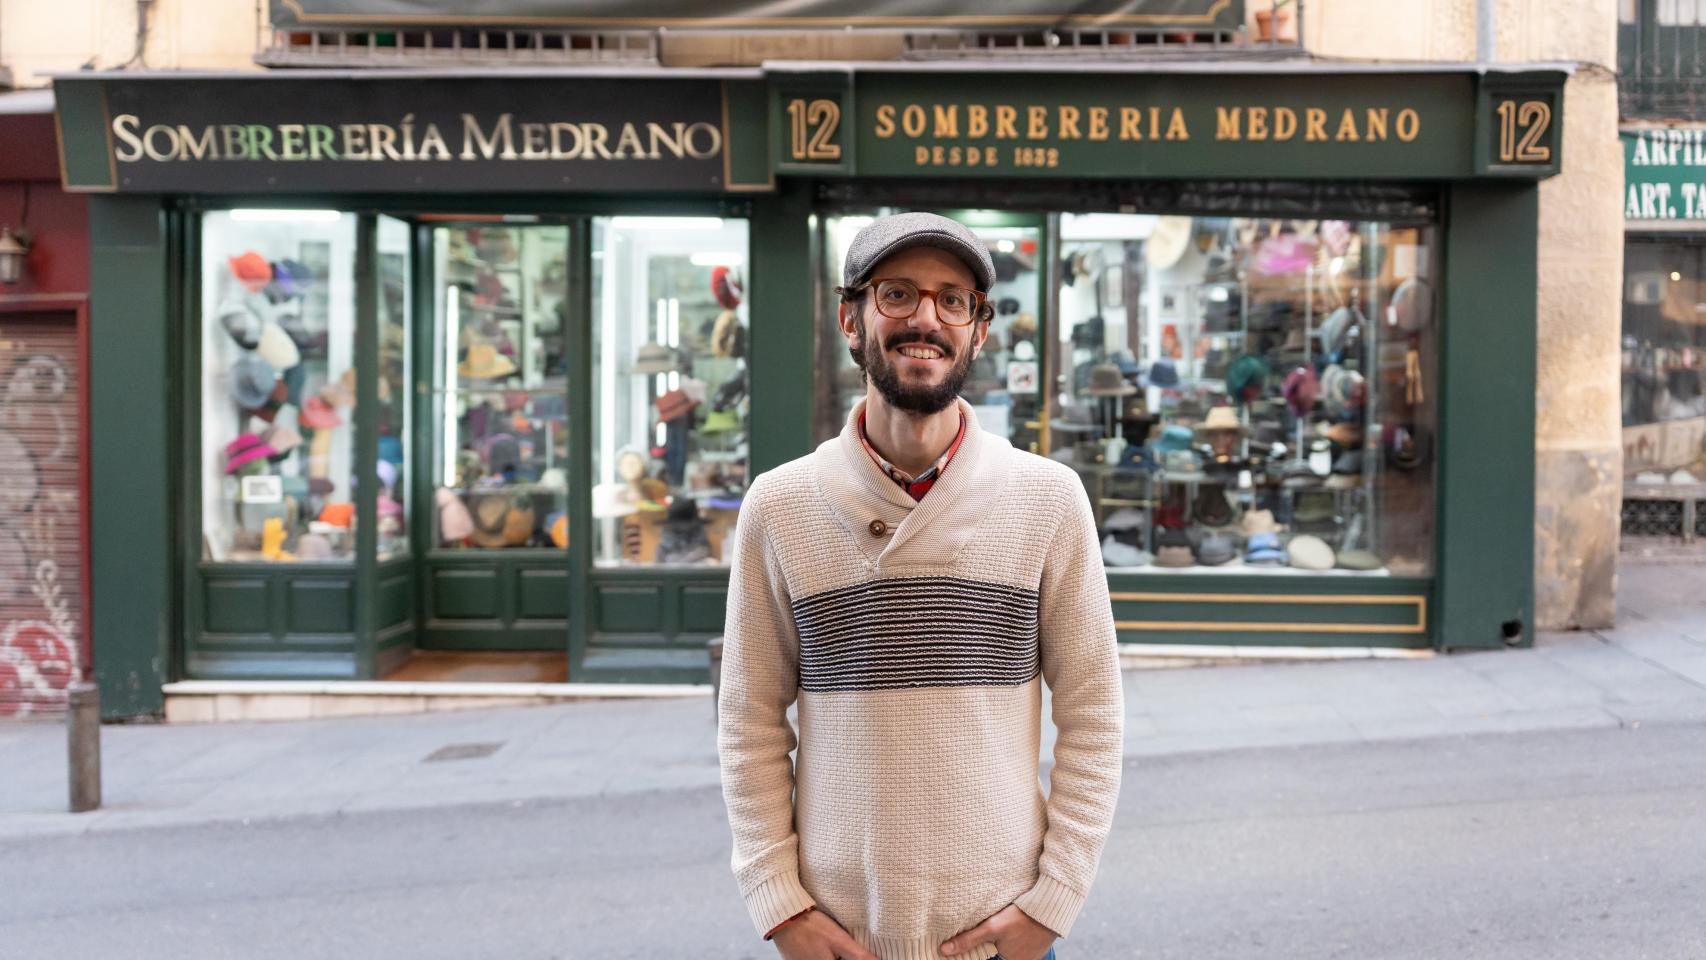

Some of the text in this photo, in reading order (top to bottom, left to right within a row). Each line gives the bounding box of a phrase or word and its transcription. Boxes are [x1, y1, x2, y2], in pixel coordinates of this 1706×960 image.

[112, 113, 722, 163] SOMBRERERÍA MEDRANO
[787, 99, 841, 159] 12
[875, 104, 1420, 142] SOMBRERERIA MEDRANO
[1497, 100, 1551, 161] 12
[915, 146, 998, 167] DESDE
[1625, 182, 1677, 219] ART.
